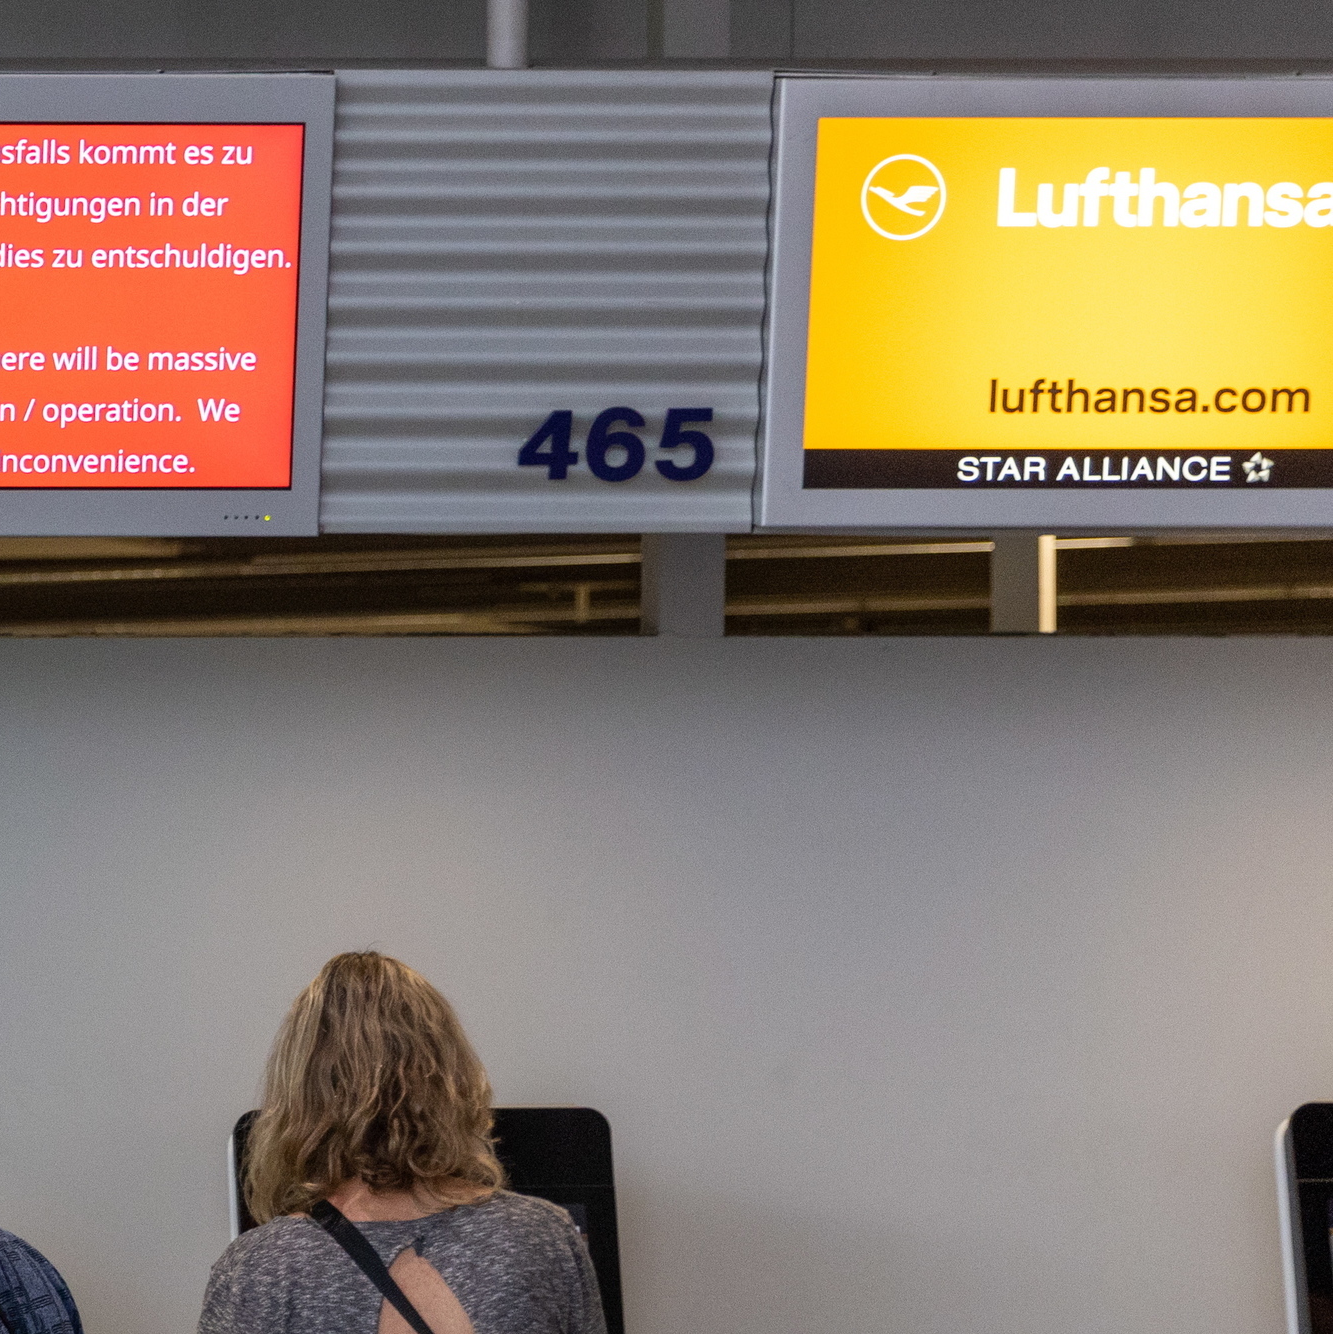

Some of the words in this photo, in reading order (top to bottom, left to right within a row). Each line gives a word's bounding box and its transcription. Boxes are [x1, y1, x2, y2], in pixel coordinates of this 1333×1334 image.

[79, 139, 176, 165] kommt
[184, 145, 213, 165] es
[221, 145, 253, 165] zu
[150, 192, 173, 217] in
[182, 191, 230, 217] der
[52, 248, 83, 269] zu
[91, 243, 292, 276] entschuldigen.
[53, 346, 98, 371] will
[107, 346, 140, 371] be
[148, 347, 257, 371] massive
[990, 378, 1310, 413] lufthansa.com
[24, 399, 36, 422] /
[43, 398, 182, 429] operation.
[198, 399, 240, 423] We
[517, 406, 715, 482] 465
[957, 456, 1047, 482] STAR
[1056, 456, 1232, 482] ALLIANCE
